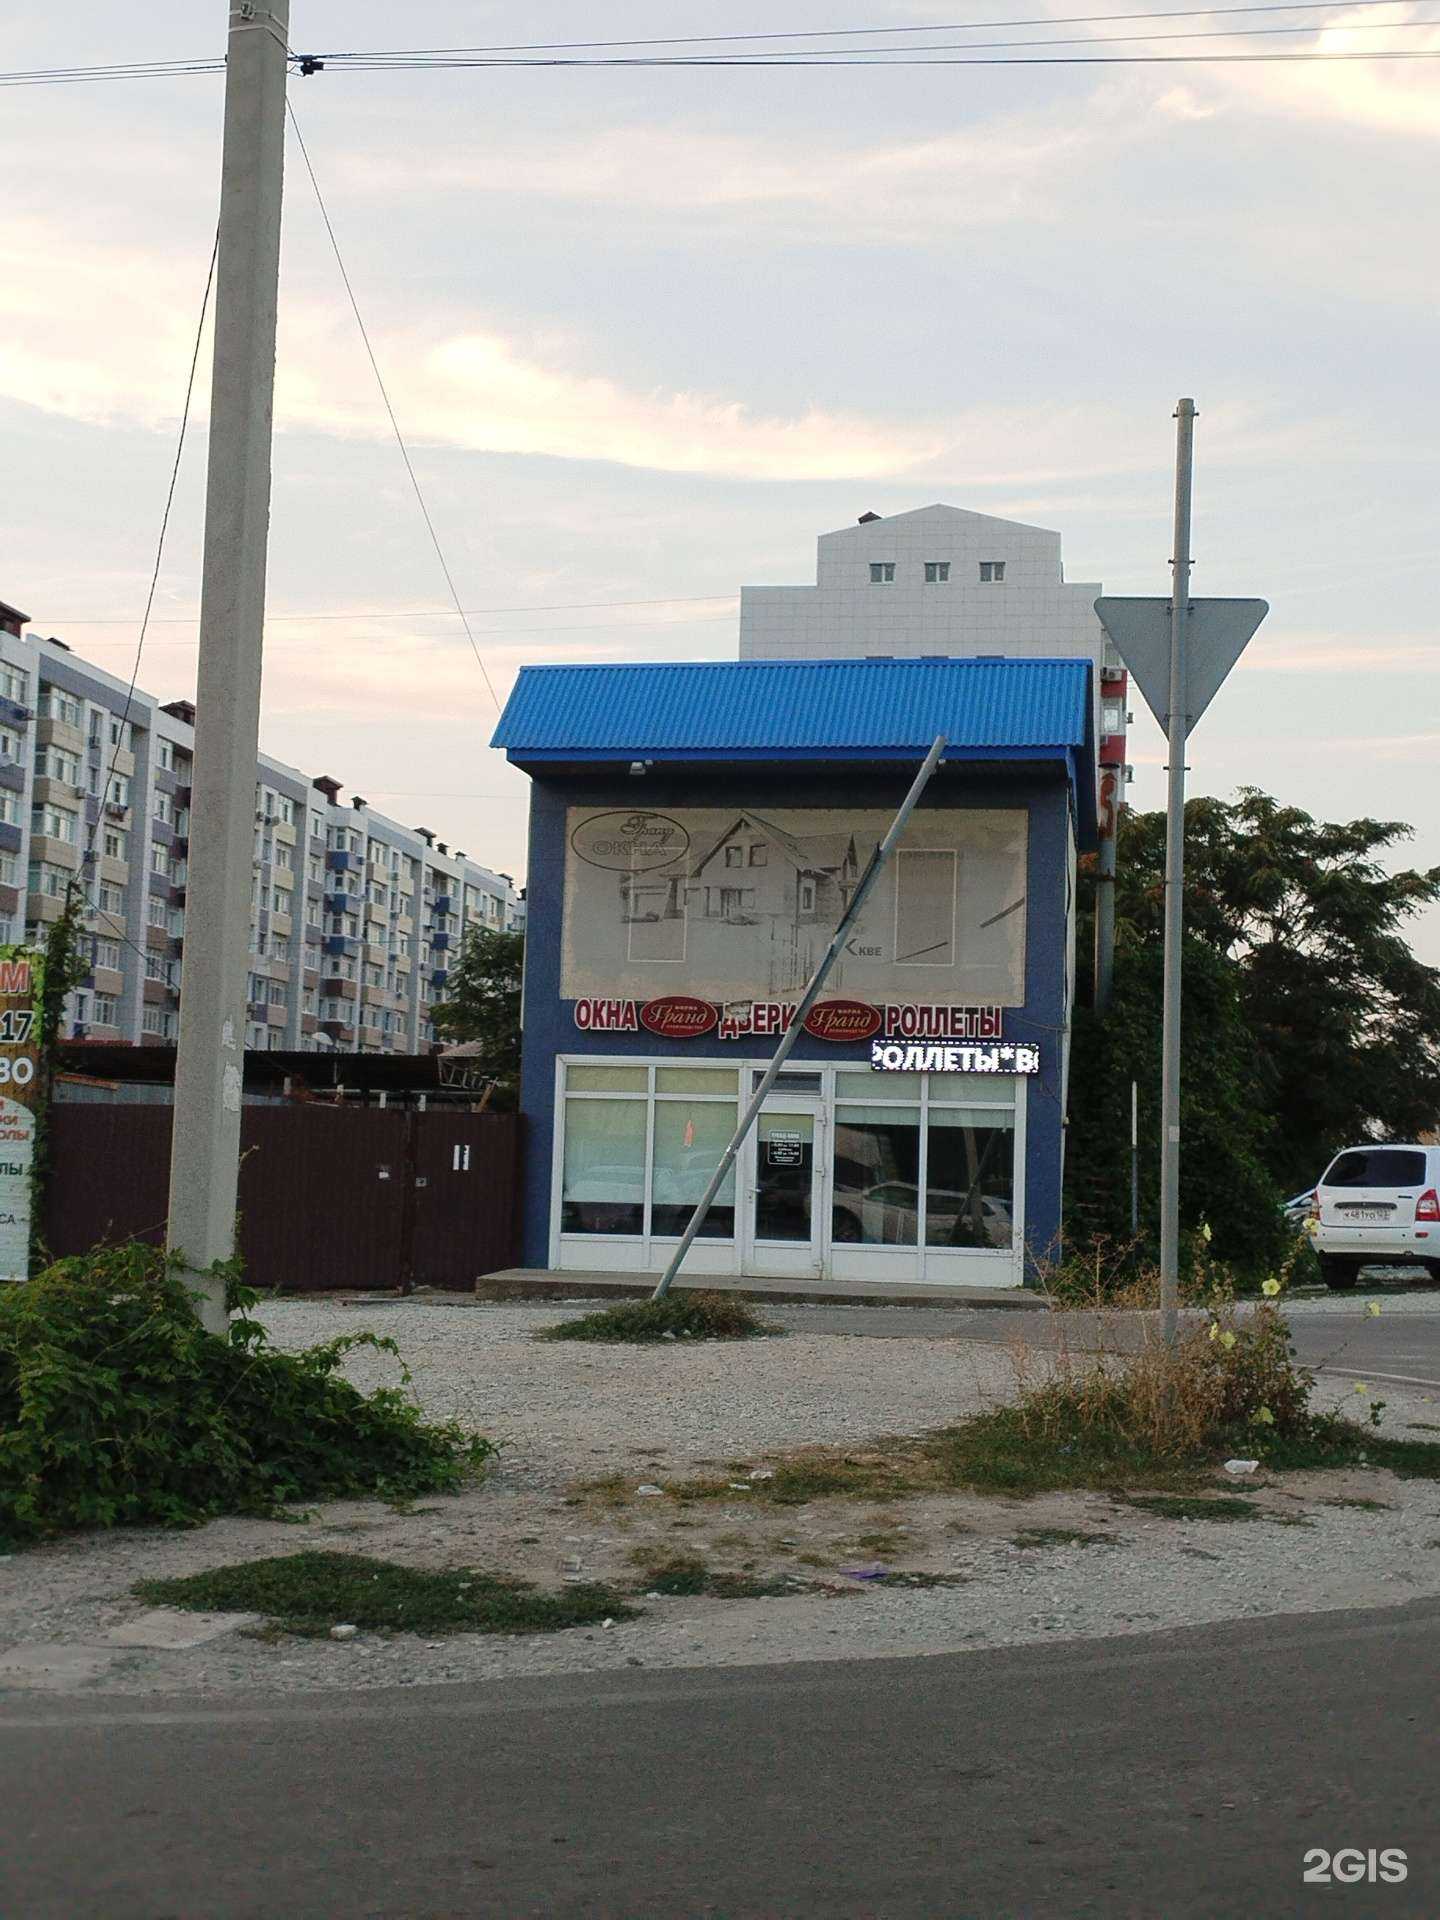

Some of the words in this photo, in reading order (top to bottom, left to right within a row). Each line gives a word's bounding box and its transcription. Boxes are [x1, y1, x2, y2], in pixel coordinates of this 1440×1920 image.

[574, 998, 638, 1030] ОКНА
[649, 1003, 707, 1030] Гранд
[811, 1007, 871, 1034] Гранд
[885, 1003, 1002, 1038] РОЛЛЕТЫ
